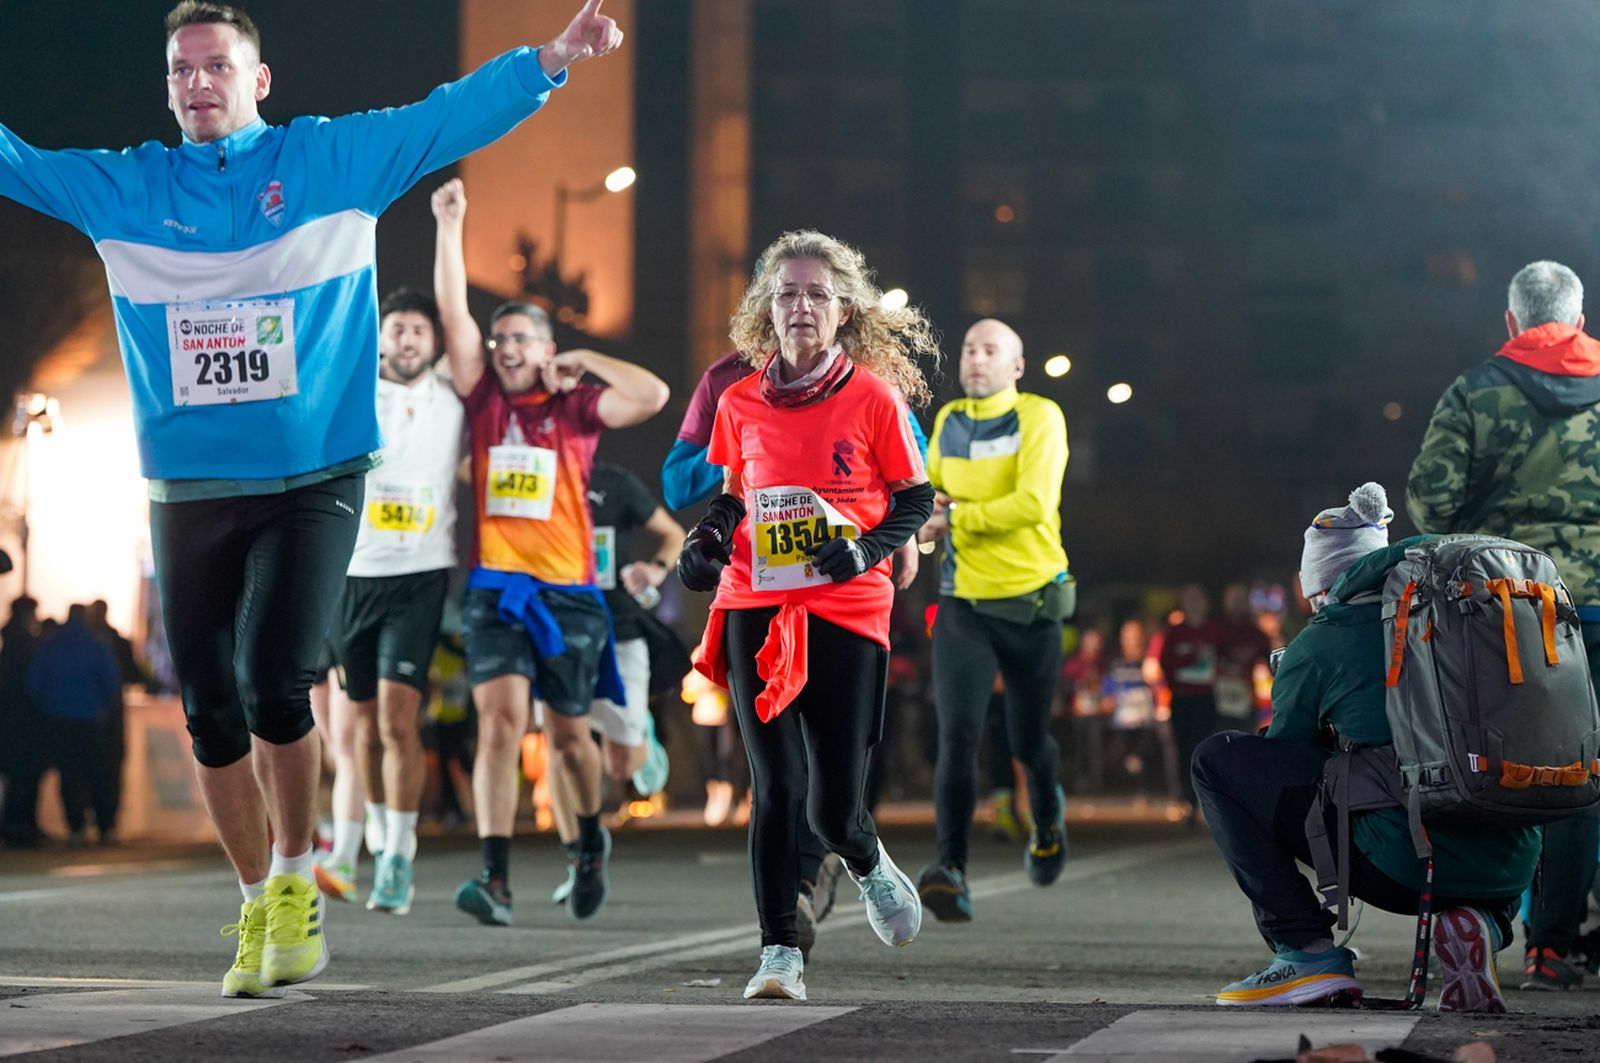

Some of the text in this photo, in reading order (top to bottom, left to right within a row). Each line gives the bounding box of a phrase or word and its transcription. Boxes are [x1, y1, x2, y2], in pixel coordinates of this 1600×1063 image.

[194, 322, 229, 335] NOCHE
[231, 321, 245, 333] DE
[183, 338, 204, 351] SAN
[195, 350, 270, 386] 2319
[217, 387, 249, 396] Salvador
[800, 496, 812, 505] DE
[780, 504, 814, 521] ANTÓN
[1256, 965, 1297, 984] HOKA
